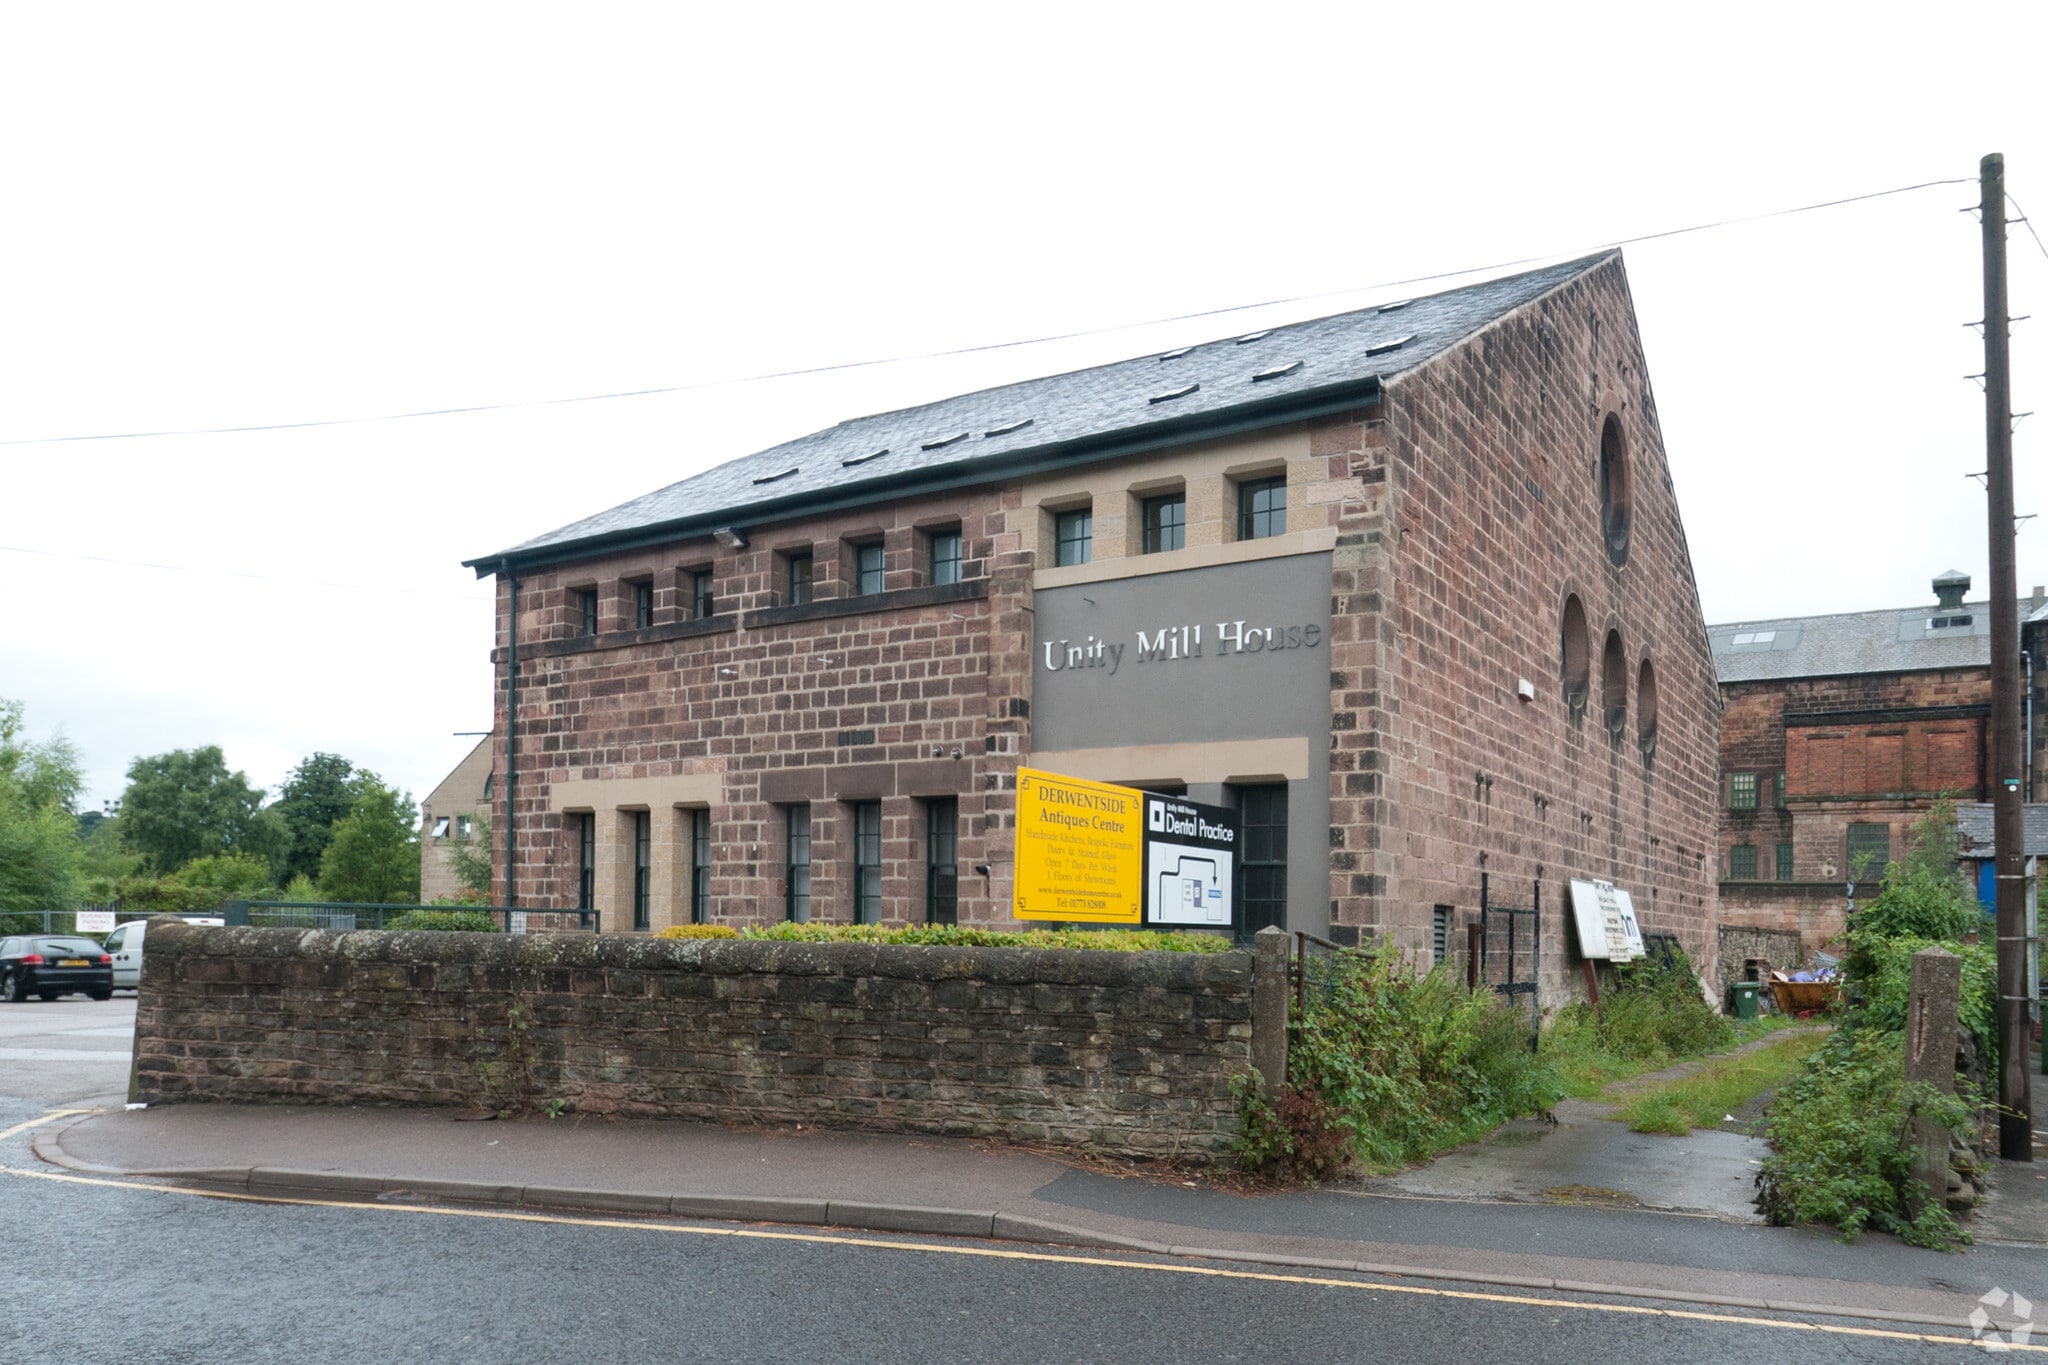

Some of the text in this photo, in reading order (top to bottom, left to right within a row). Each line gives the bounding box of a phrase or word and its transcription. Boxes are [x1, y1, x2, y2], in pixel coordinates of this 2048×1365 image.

[1043, 620, 1321, 675] Unity Mill House
[1039, 786, 1126, 814] DERWENTSIDE
[1039, 807, 1125, 833] Antiques Centre
[1166, 812, 1234, 842] Dental Practice
[1045, 857, 1117, 873] Open 7 Days Per Week
[1047, 844, 1065, 854] Doors
[1068, 847, 1075, 856] &
[1101, 850, 1116, 860] Glass
[1053, 871, 1072, 881] Floors
[1075, 871, 1082, 881] of
